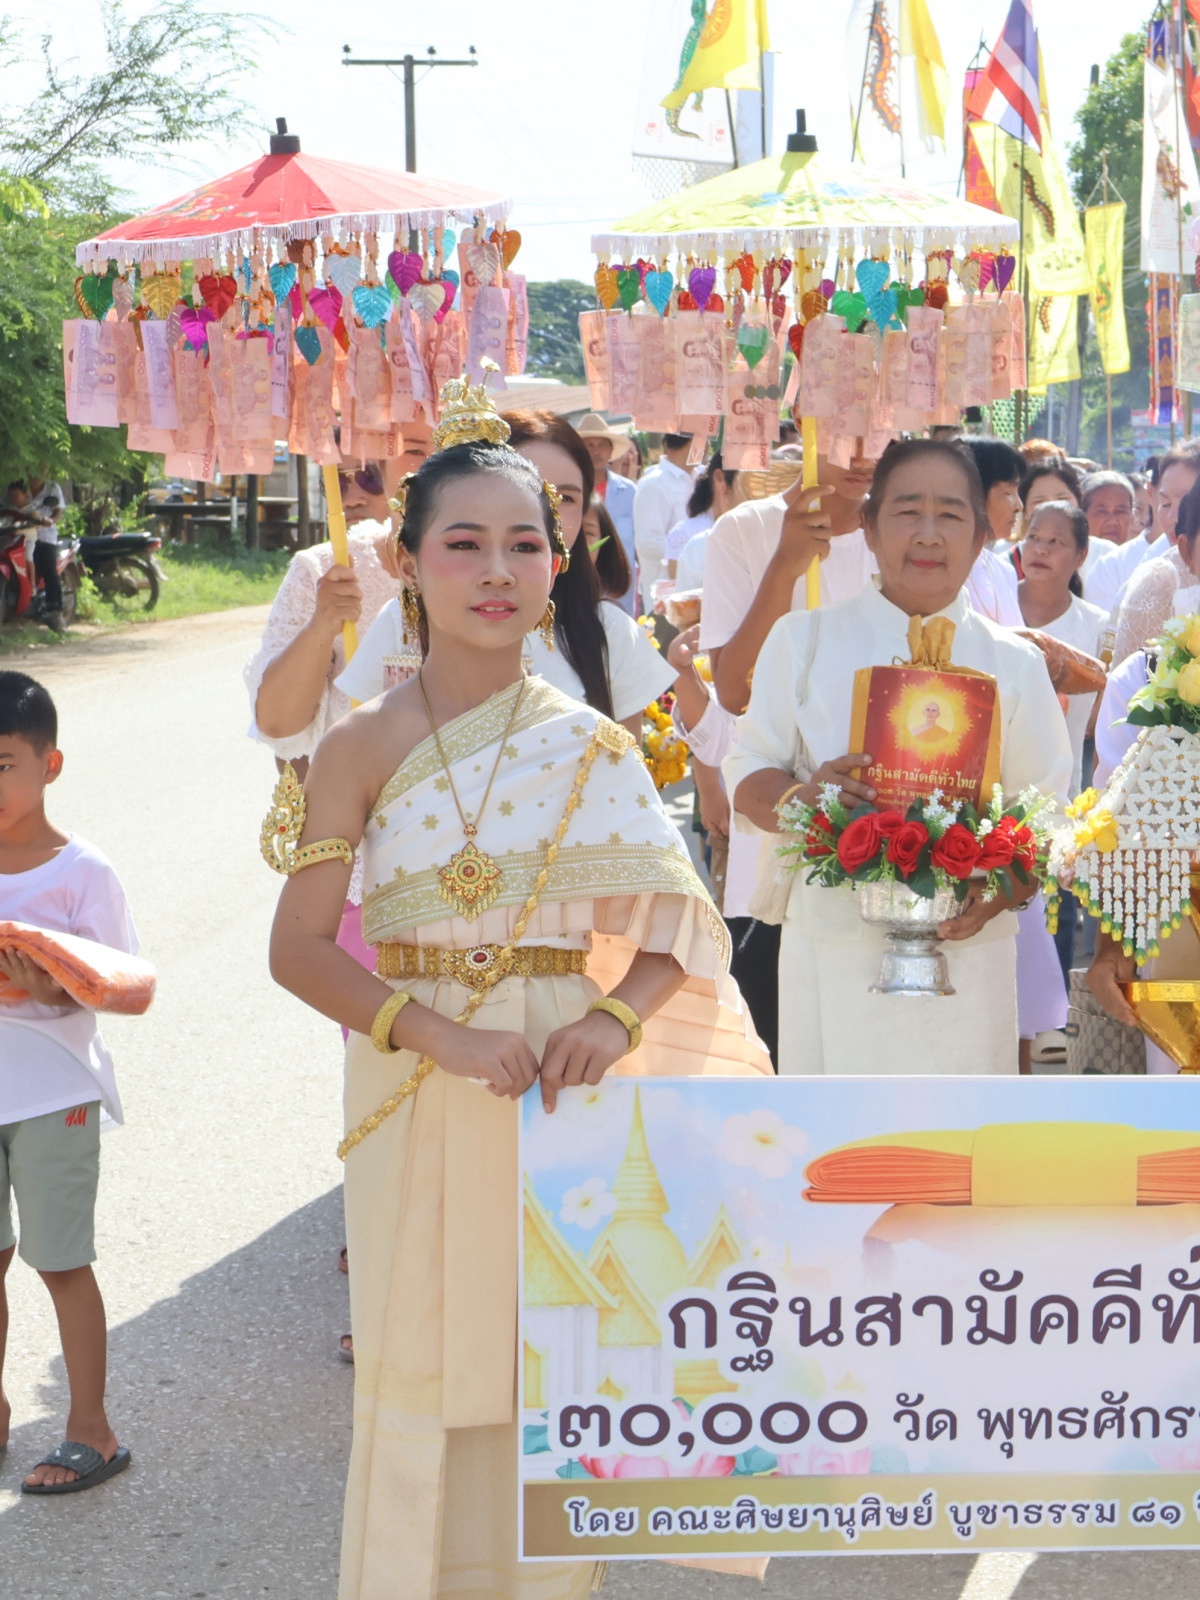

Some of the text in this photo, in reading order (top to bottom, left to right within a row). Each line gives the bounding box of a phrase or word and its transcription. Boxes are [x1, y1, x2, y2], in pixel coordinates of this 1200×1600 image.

[559, 1401, 868, 1458] ๓๐,๐๐๐
[893, 1392, 958, 1443] วัด
[568, 1500, 635, 1533] โดย
[652, 1493, 934, 1539] คณะศิษยานุศิษย์
[950, 1501, 1117, 1537] บูชาธรรม
[1132, 1501, 1182, 1525] ๘๑
